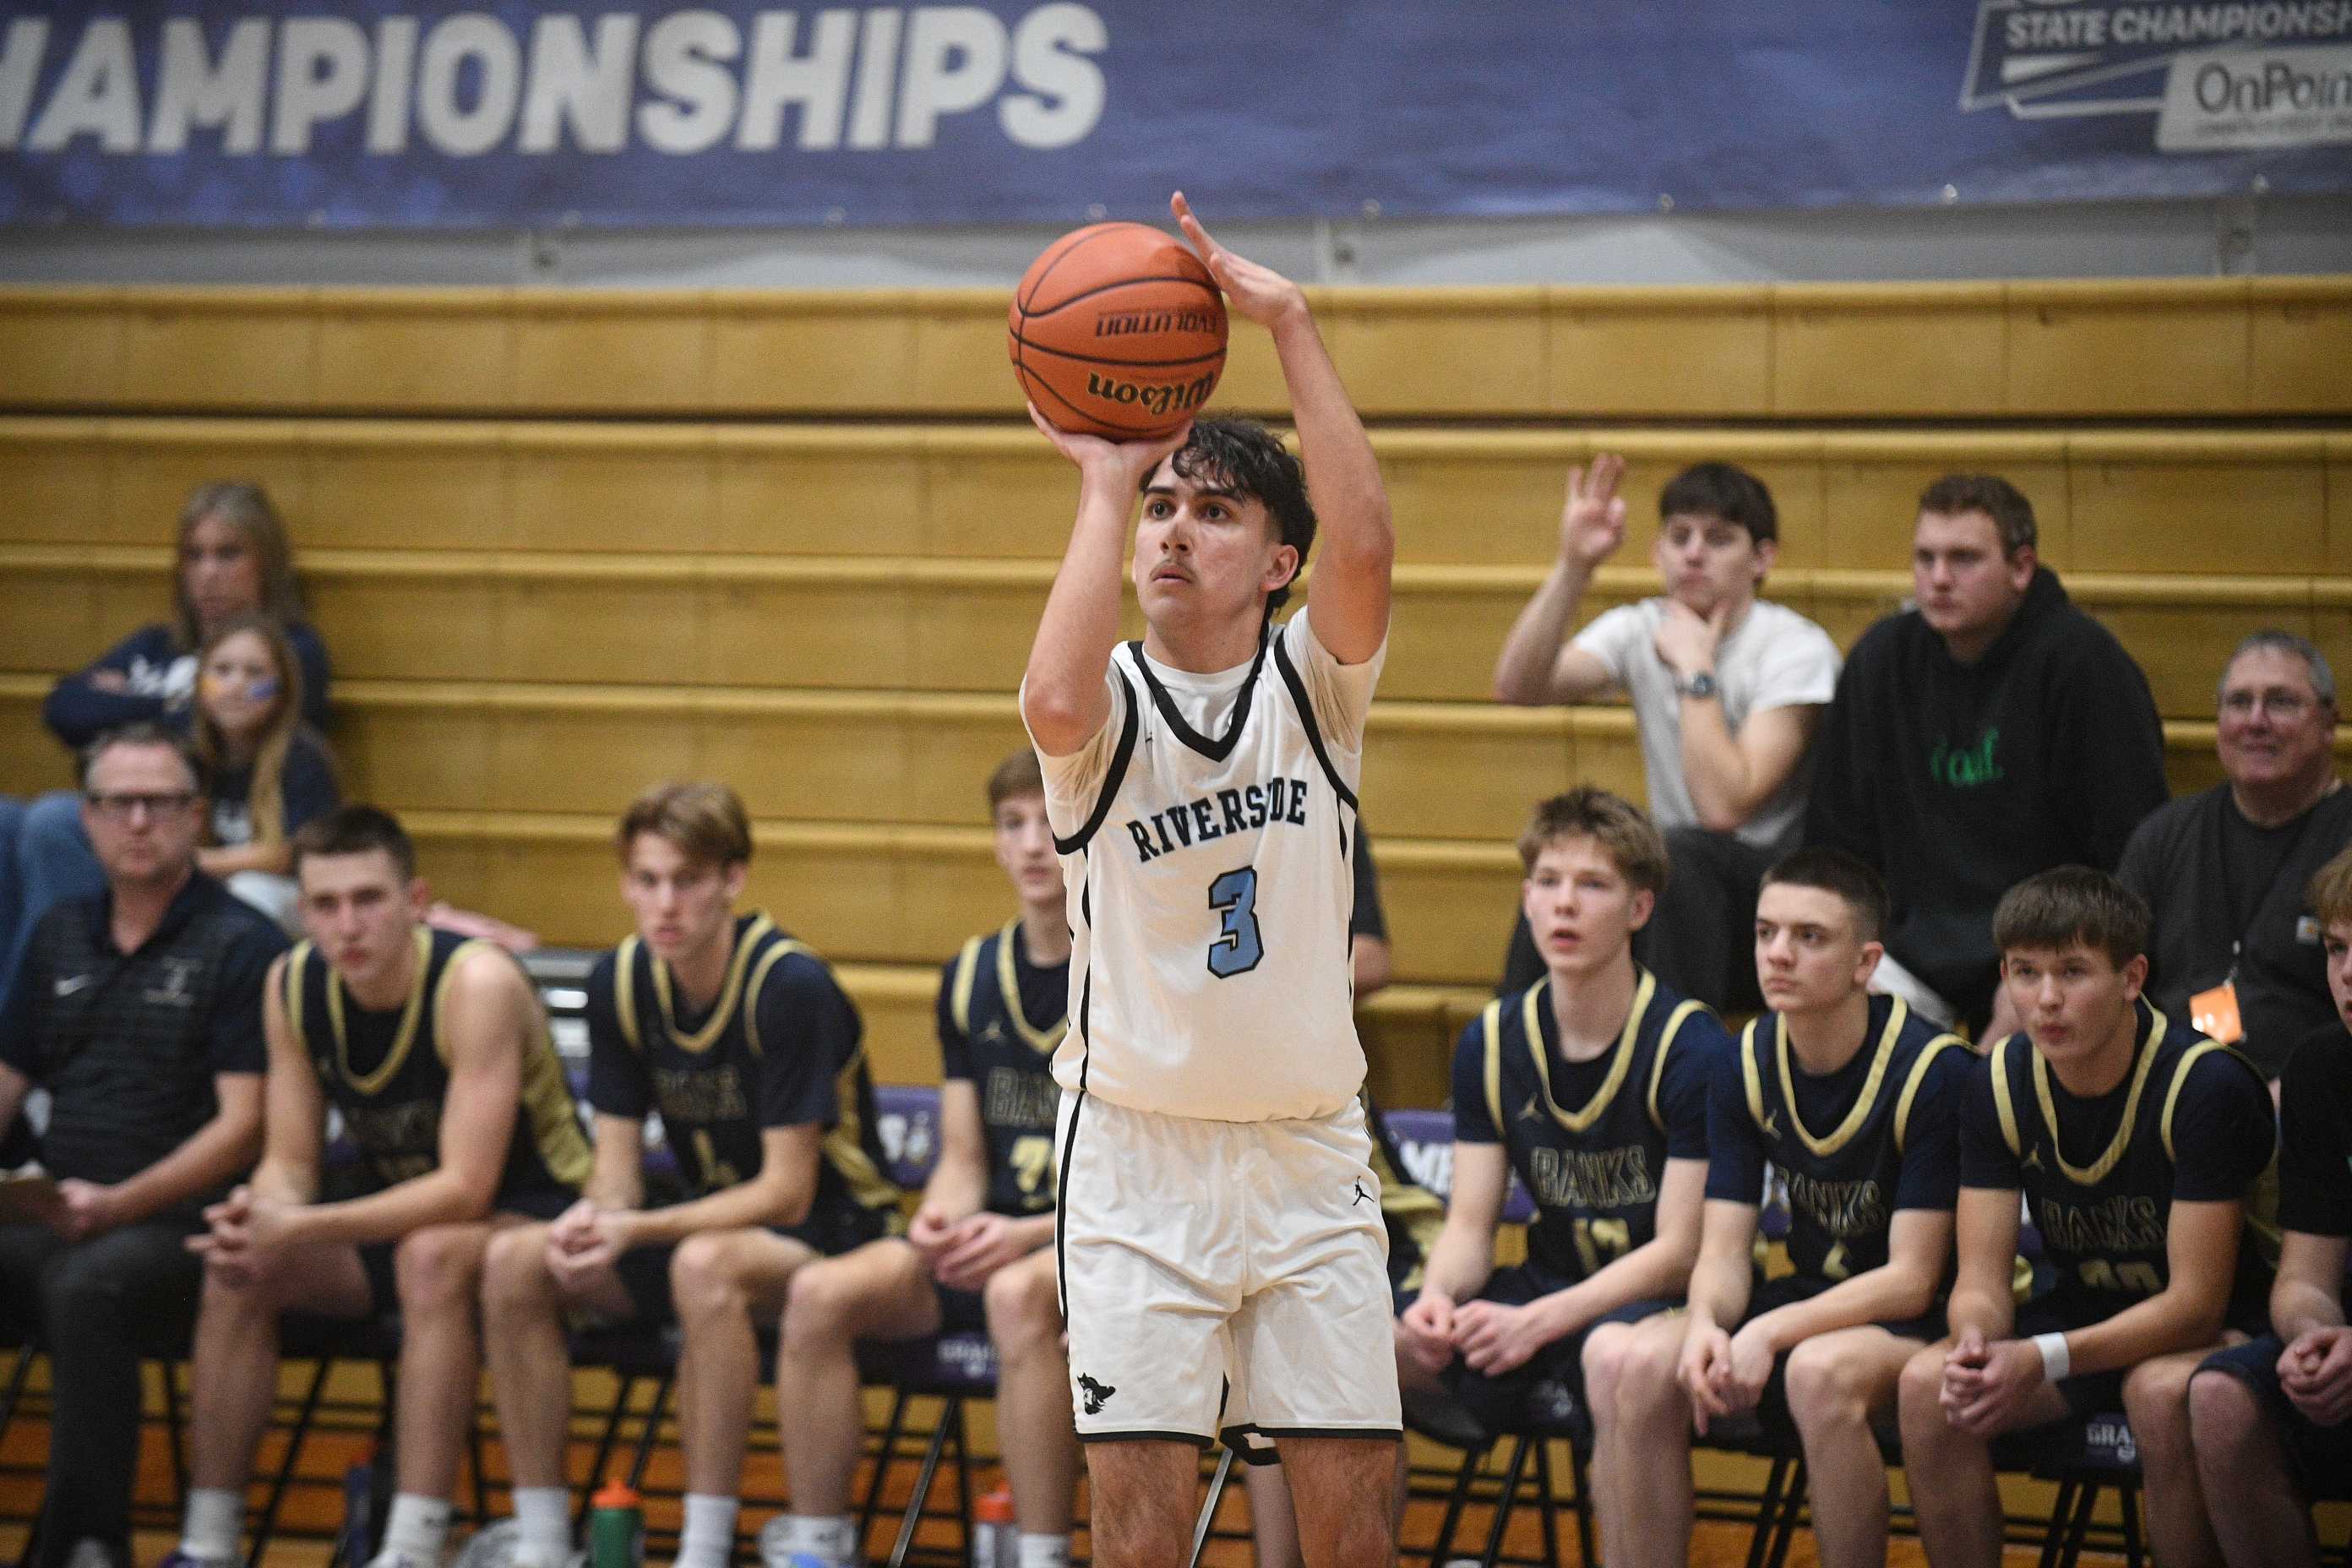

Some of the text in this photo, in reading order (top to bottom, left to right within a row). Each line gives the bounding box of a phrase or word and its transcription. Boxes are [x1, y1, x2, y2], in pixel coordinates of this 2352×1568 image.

[2005, 8, 2107, 48] STATE
[1086, 369, 1215, 416] Wilson
[1126, 776, 1308, 863] RIVERSDE
[1207, 864, 1264, 979] 3
[1530, 1145, 1657, 1208] BANKS
